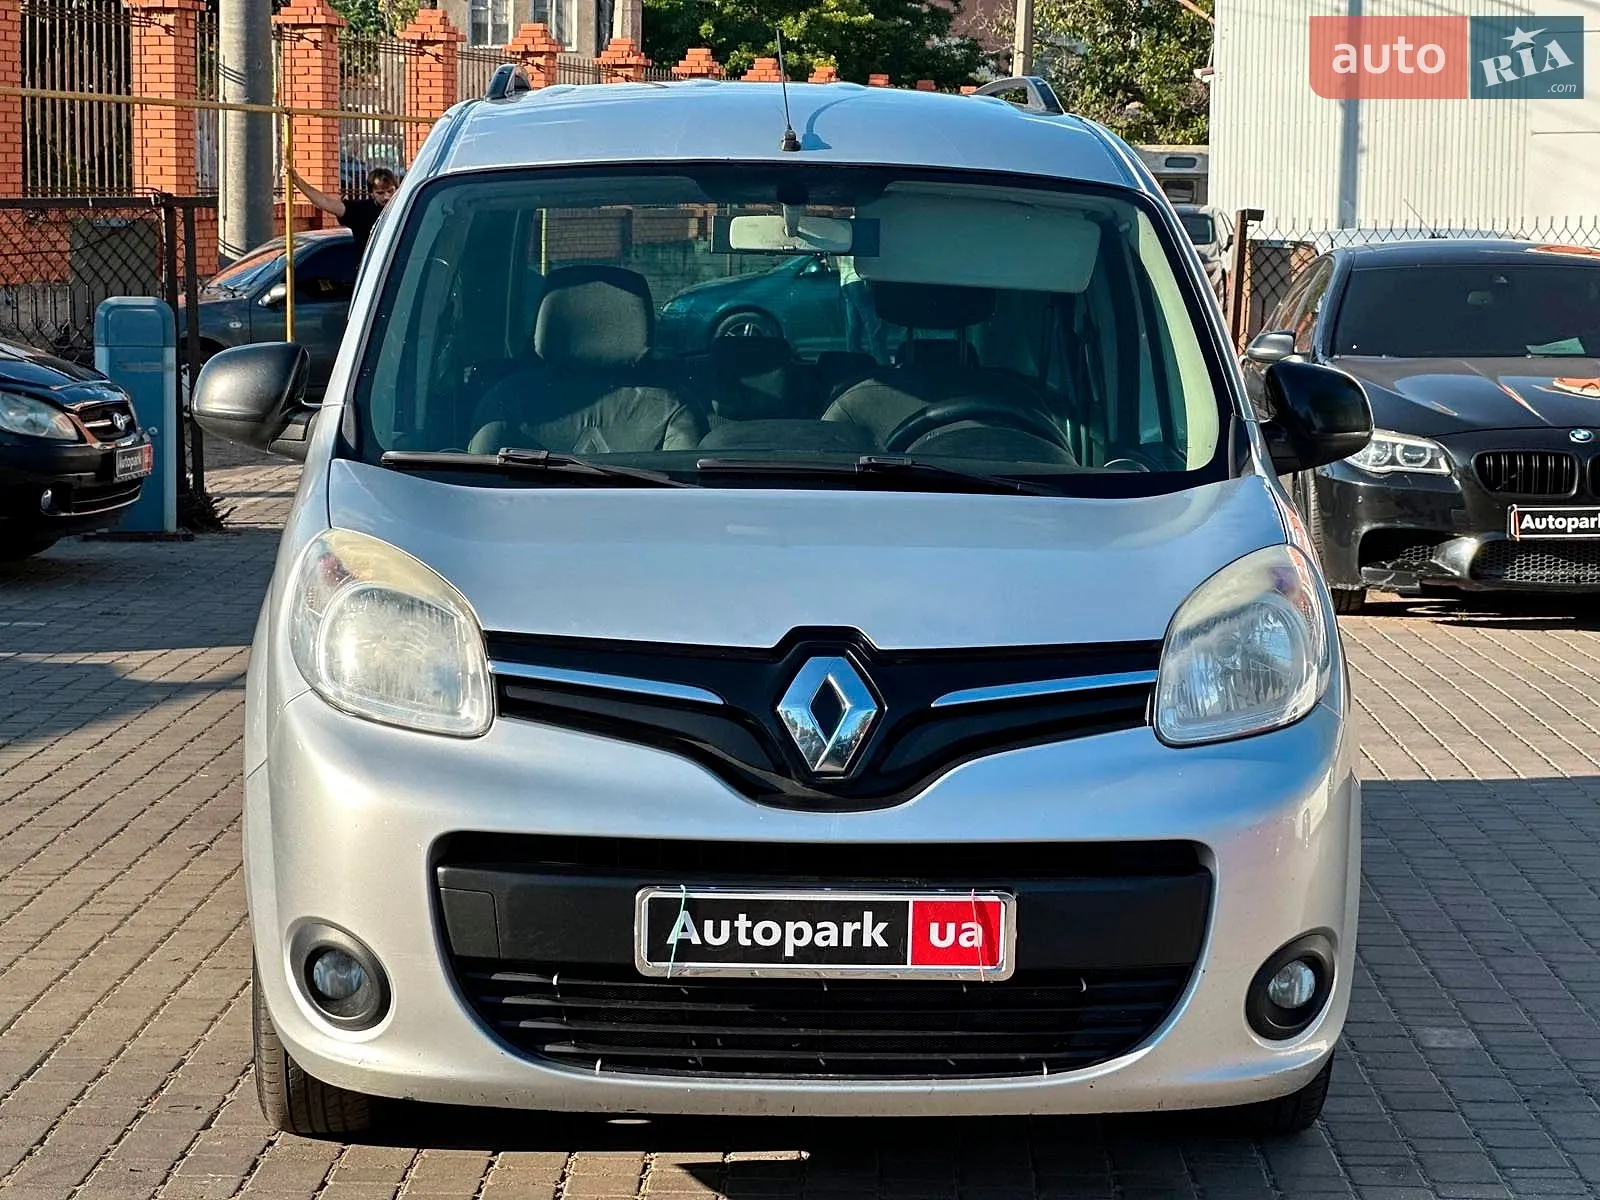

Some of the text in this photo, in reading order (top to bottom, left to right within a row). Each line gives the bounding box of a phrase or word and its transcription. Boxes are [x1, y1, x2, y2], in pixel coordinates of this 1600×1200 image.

[1520, 513, 1600, 533] Autopar
[667, 910, 983, 957] Autopark ua
